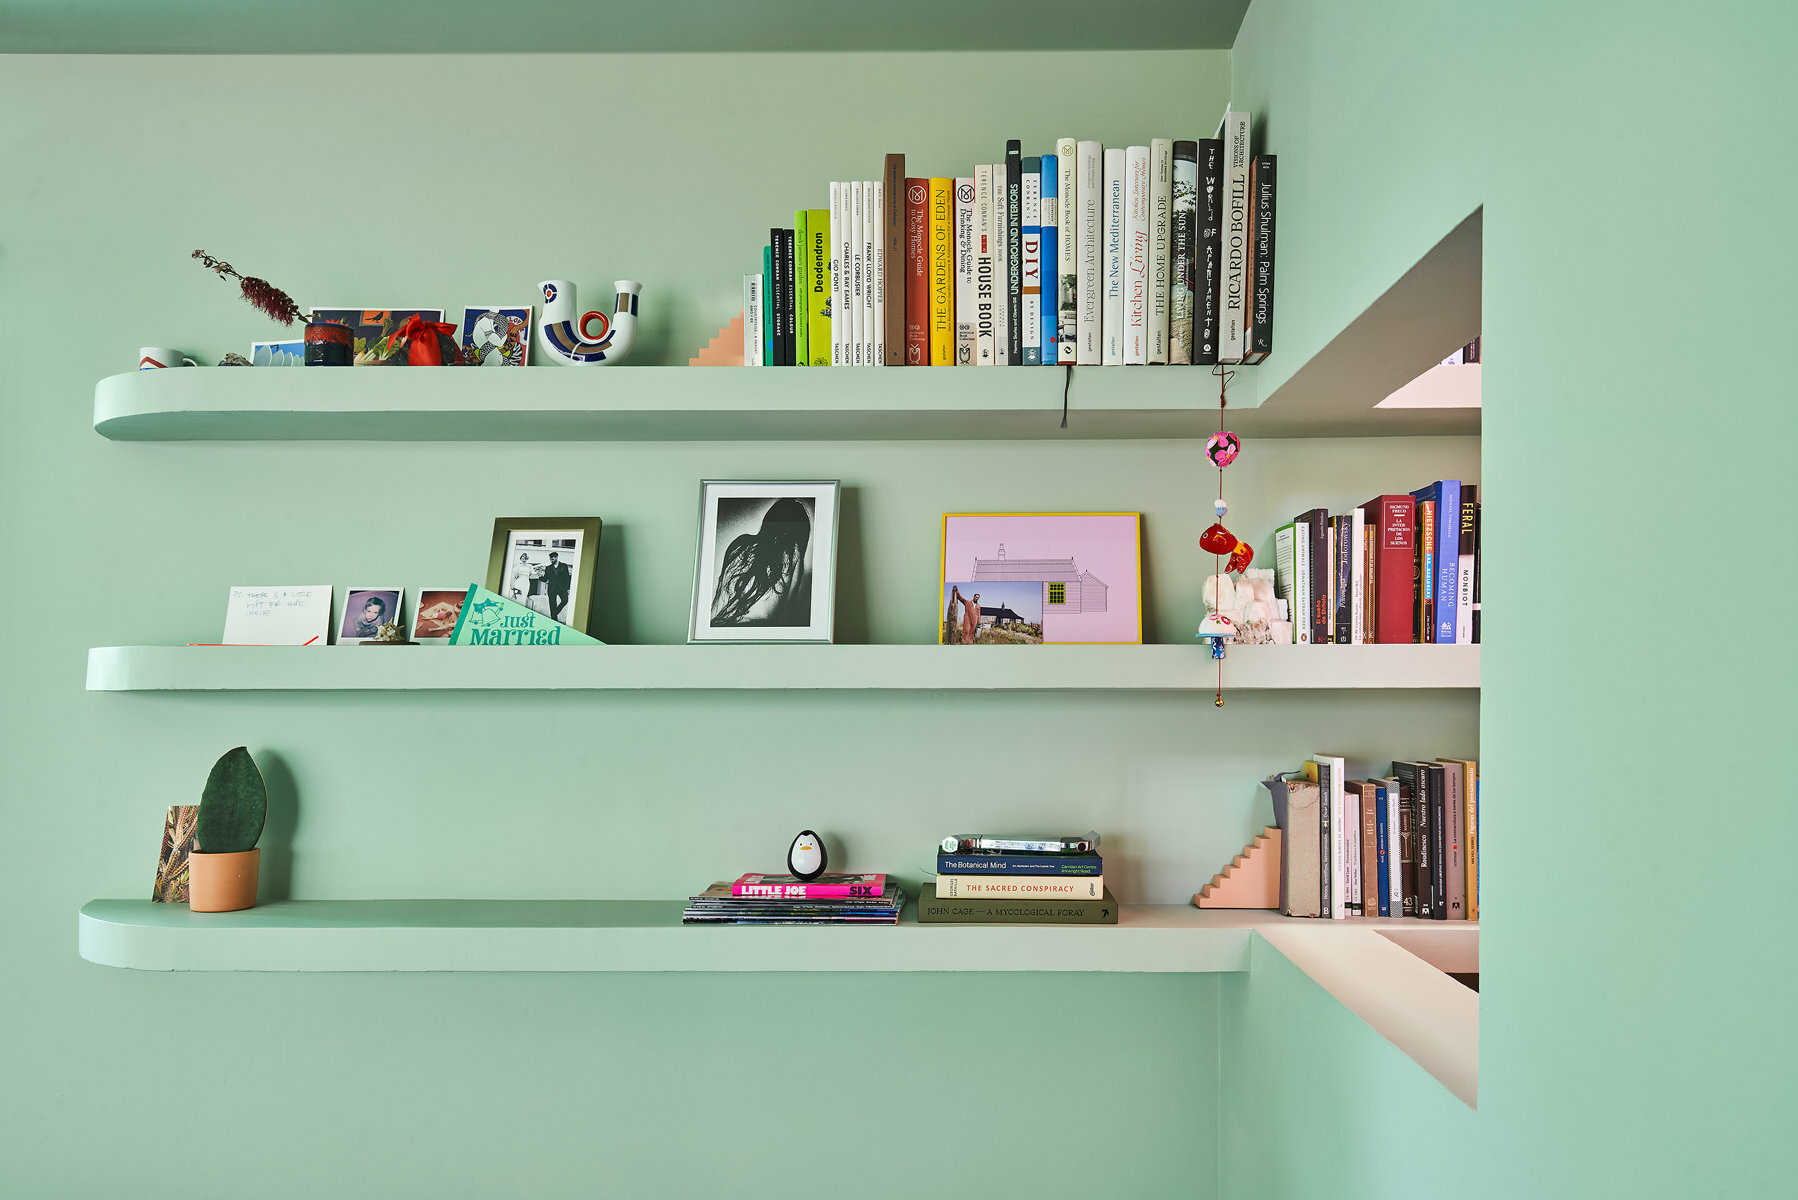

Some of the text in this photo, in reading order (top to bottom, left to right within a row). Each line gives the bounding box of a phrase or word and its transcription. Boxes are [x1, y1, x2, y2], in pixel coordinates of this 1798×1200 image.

[1133, 161, 1141, 171] for
[959, 209, 967, 239] Drinking
[996, 212, 1005, 247] Furnishings
[1178, 212, 1186, 230] SUN
[1011, 184, 1019, 294] UNDERGROUND INTERIORS
[1109, 180, 1120, 299] The New Mediterranean
[1156, 196, 1166, 315] THE HOME UPGRADE
[1177, 233, 1185, 251] THE
[1228, 174, 1245, 310] RICARDO BOFILL
[1256, 183, 1272, 324] Julius Shulman: Palm Springs
[814, 232, 823, 293] Deodendron
[936, 189, 946, 332] THE GARDENS OF EDEN
[959, 250, 967, 273] Dining
[1026, 240, 1038, 278] DIY
[1084, 200, 1097, 322] Evergreen Architecture
[1177, 253, 1185, 285] UNDER
[978, 257, 992, 298] HOUSE
[1130, 231, 1146, 327] Kitchen Living
[978, 303, 992, 337] BOOK
[1030, 300, 1035, 309] BY
[1177, 288, 1185, 319] LIVING
[1462, 503, 1474, 534] FERAL
[1341, 522, 1350, 564] Jodorowsky
[469, 626, 561, 646] Married
[500, 612, 536, 628] Just
[742, 886, 806, 895] LITTLE JOE
[850, 887, 872, 895] SIX
[1403, 897, 1413, 906] 43
